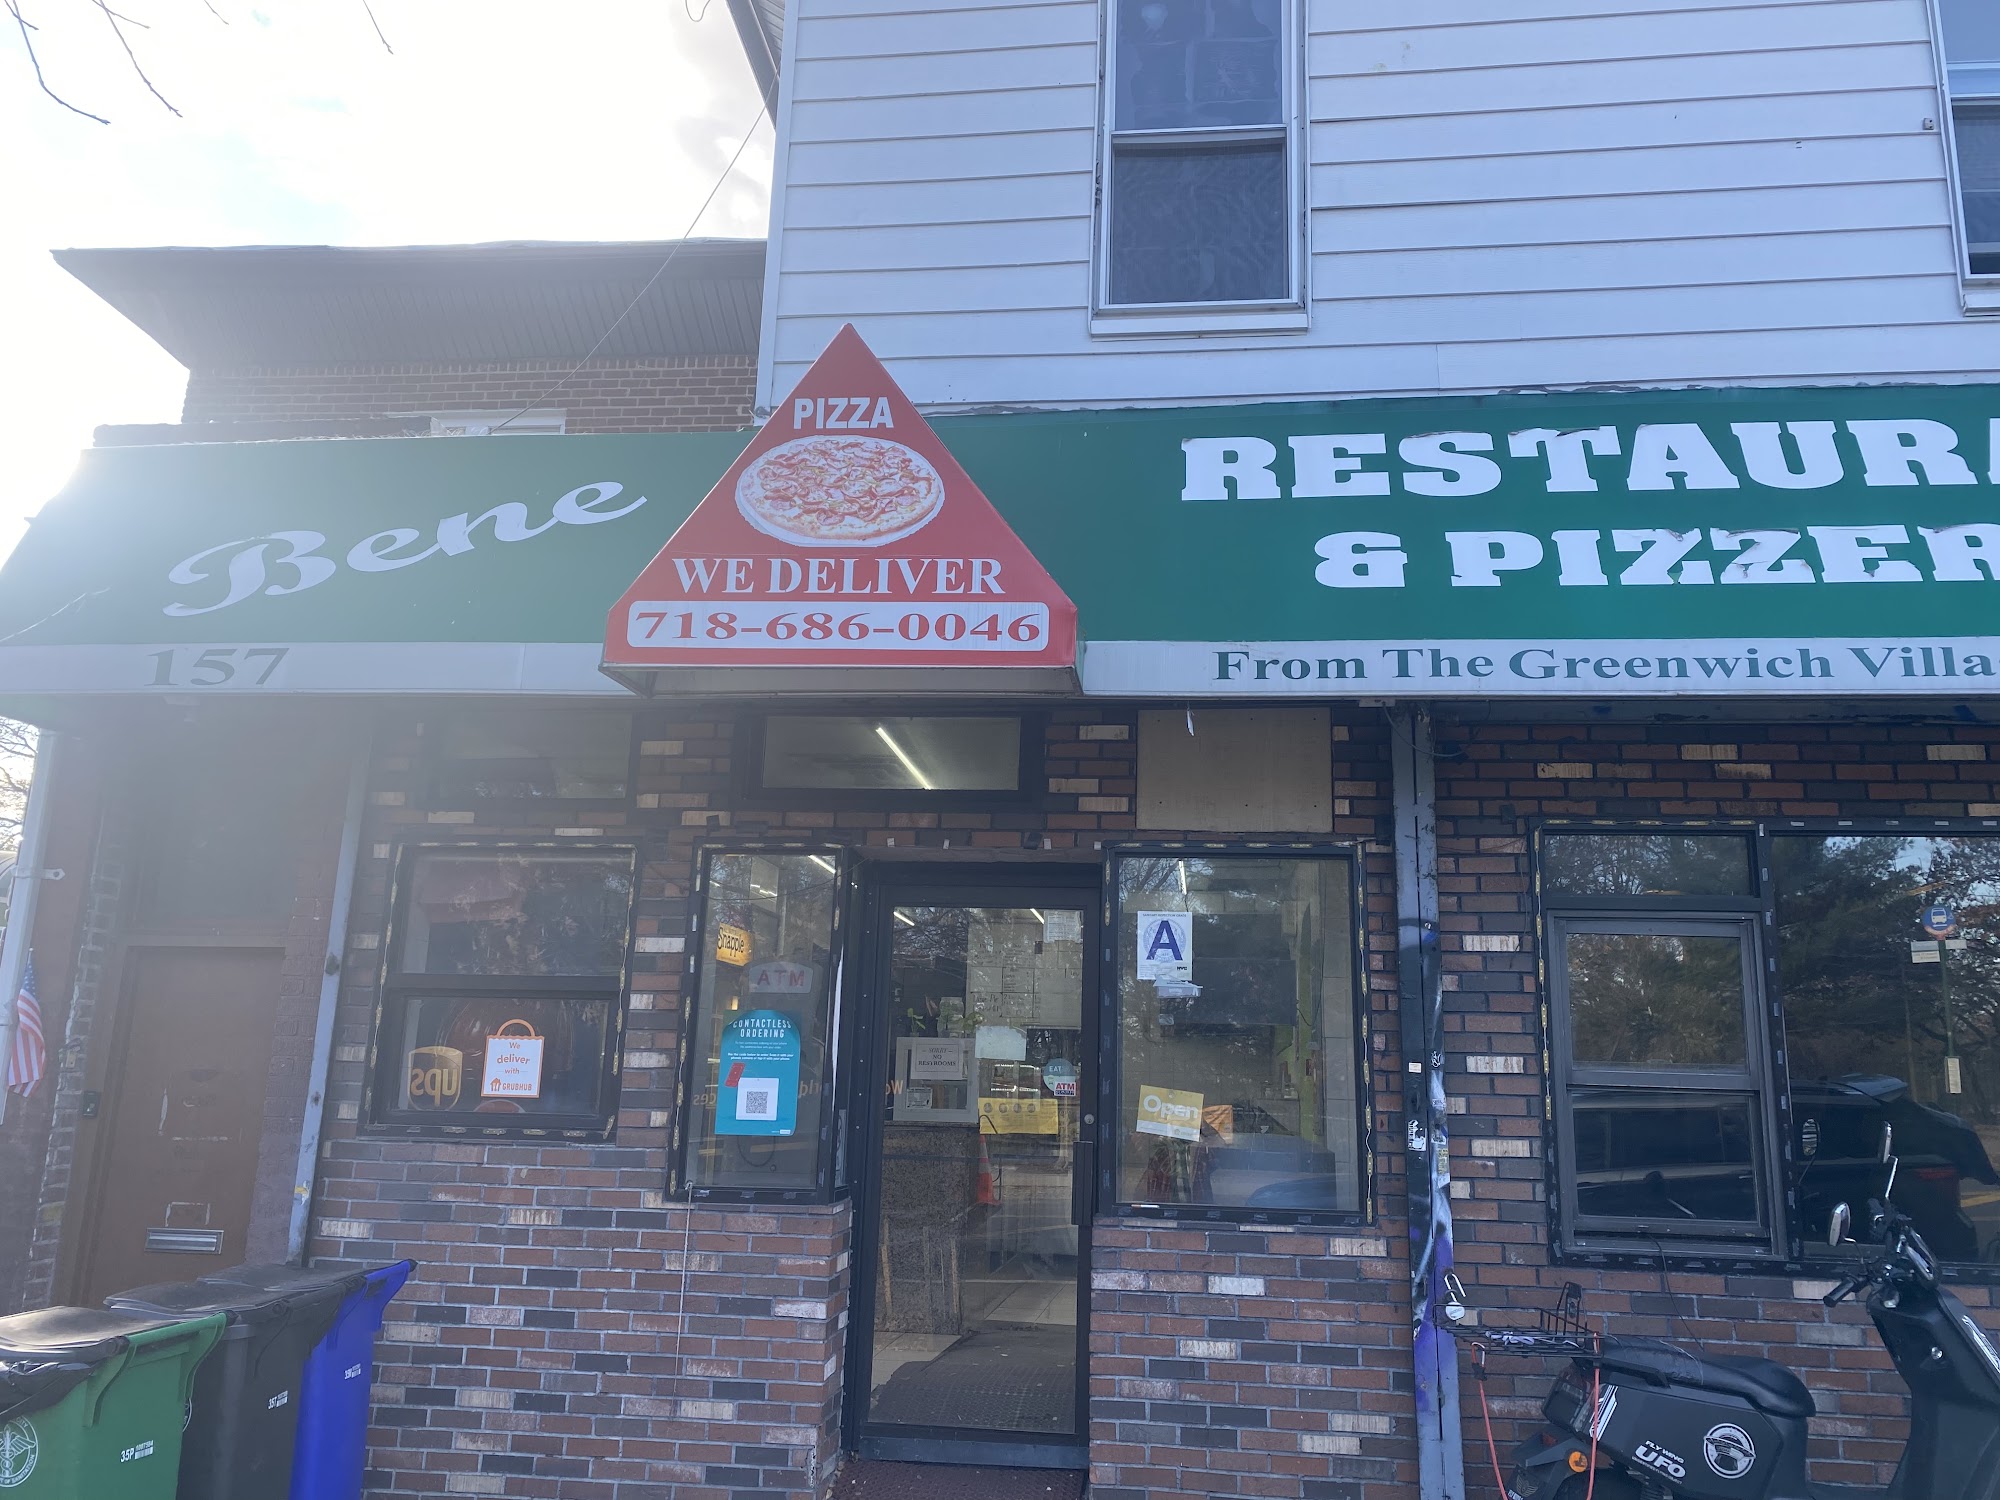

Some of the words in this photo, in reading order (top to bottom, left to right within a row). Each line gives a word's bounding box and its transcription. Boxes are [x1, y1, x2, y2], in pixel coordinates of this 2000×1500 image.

[794, 397, 894, 430] PIZZA
[1181, 419, 2000, 501] RESTAUR
[162, 481, 648, 616] Bene
[1314, 531, 1408, 588] &
[1446, 524, 2000, 588] PIZZER
[672, 558, 755, 594] WE
[766, 557, 1007, 595] DELIVER
[635, 611, 1041, 642] 718-686-0046
[144, 648, 290, 686] 157
[1213, 649, 1368, 682] From
[1382, 647, 1495, 680] The
[1508, 646, 1838, 681] Greenwich
[1846, 645, 2000, 679] Villa
[717, 927, 745, 957] Snapple
[1146, 920, 1183, 960] A
[757, 969, 805, 987] ATM
[732, 1018, 792, 1029] CONTACTLESS
[740, 1029, 785, 1038] ORDERING
[509, 1041, 521, 1049] We
[496, 1054, 531, 1065] deliver
[1049, 1065, 1062, 1073] EAT
[502, 1083, 533, 1091] GRUBHUB
[1055, 1083, 1075, 1091] ATM
[1143, 1094, 1199, 1121] Open
[120, 1447, 135, 1463] 35P
[1635, 1444, 1686, 1478] UFO
[1645, 1440, 1663, 1450] FLY
[1662, 1448, 1685, 1464] WING
